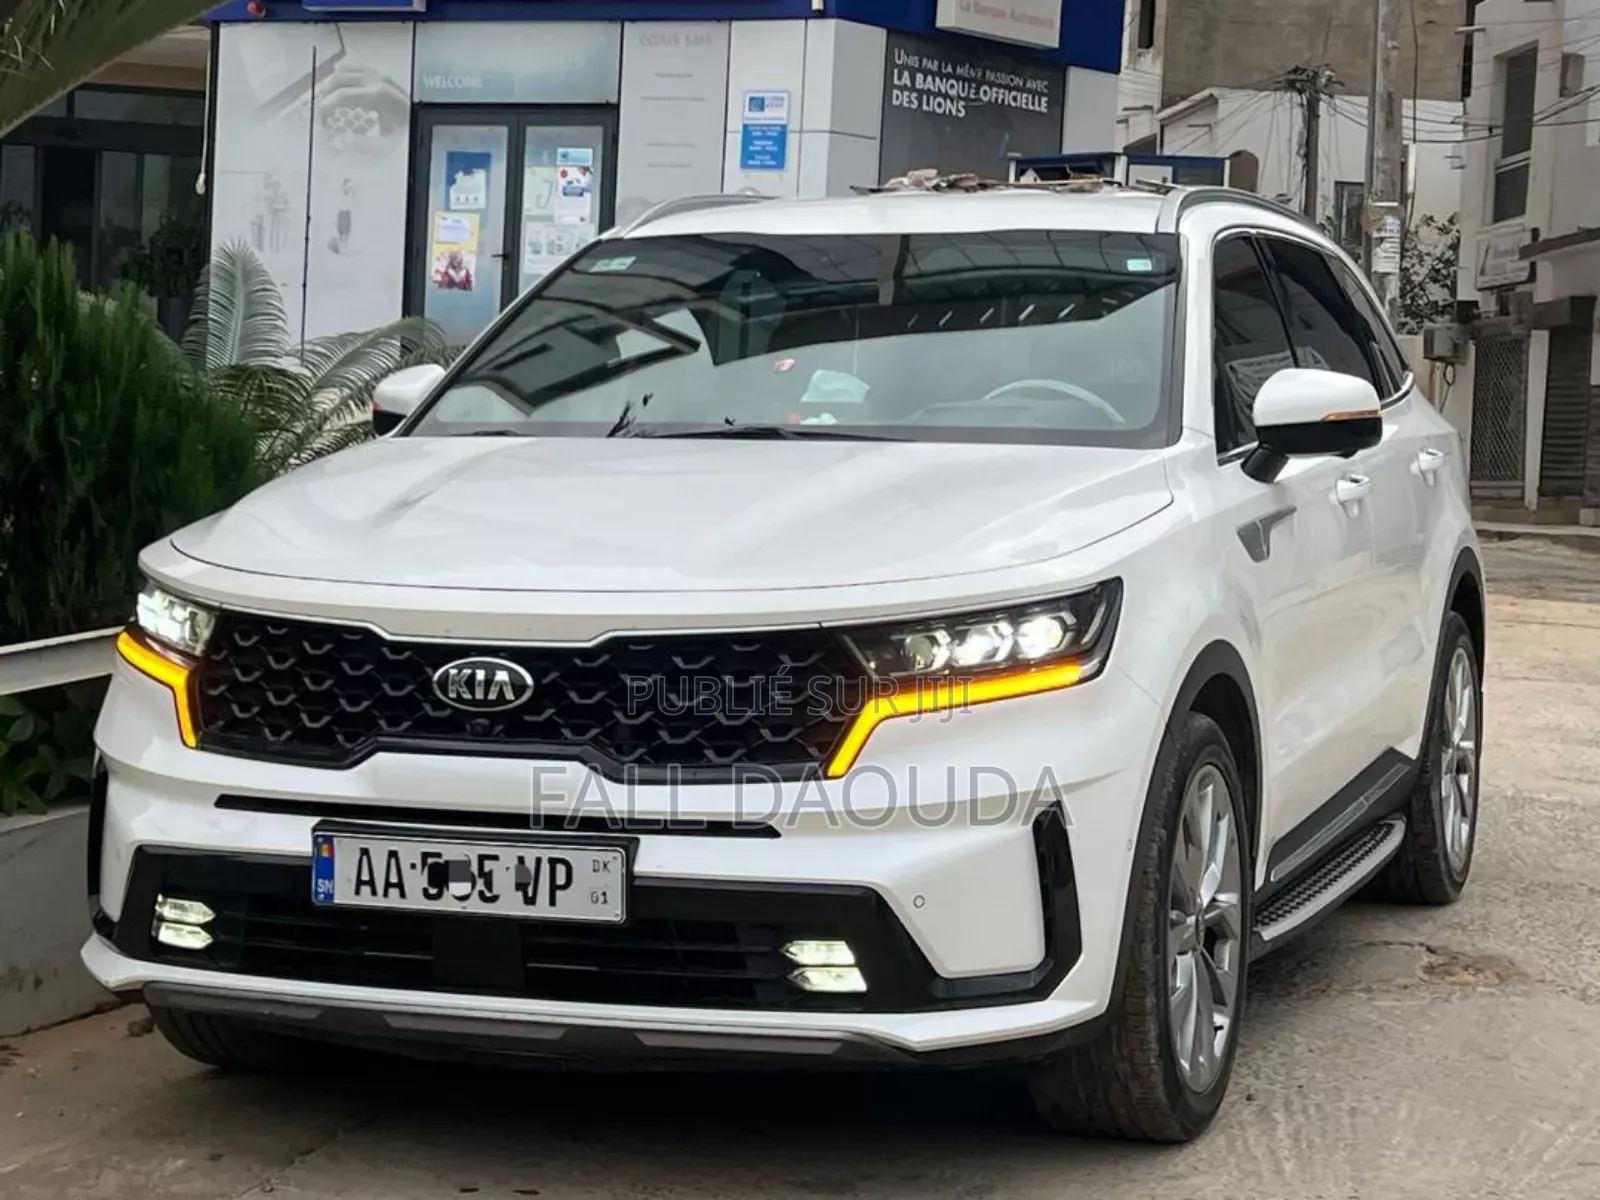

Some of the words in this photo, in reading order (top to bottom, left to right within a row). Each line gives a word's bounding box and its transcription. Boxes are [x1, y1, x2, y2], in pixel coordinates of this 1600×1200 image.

[922, 57, 939, 72] PAR
[941, 61, 953, 74] LA
[985, 69, 1023, 87] PASSION
[1025, 78, 1049, 93] AVEC
[892, 89, 918, 109] DES
[922, 93, 966, 118] LIONS
[893, 68, 911, 87] LA
[979, 85, 1048, 113] OFFICIELLE
[447, 668, 516, 700] KIA
[592, 858, 611, 874] DK
[317, 878, 334, 894] SN
